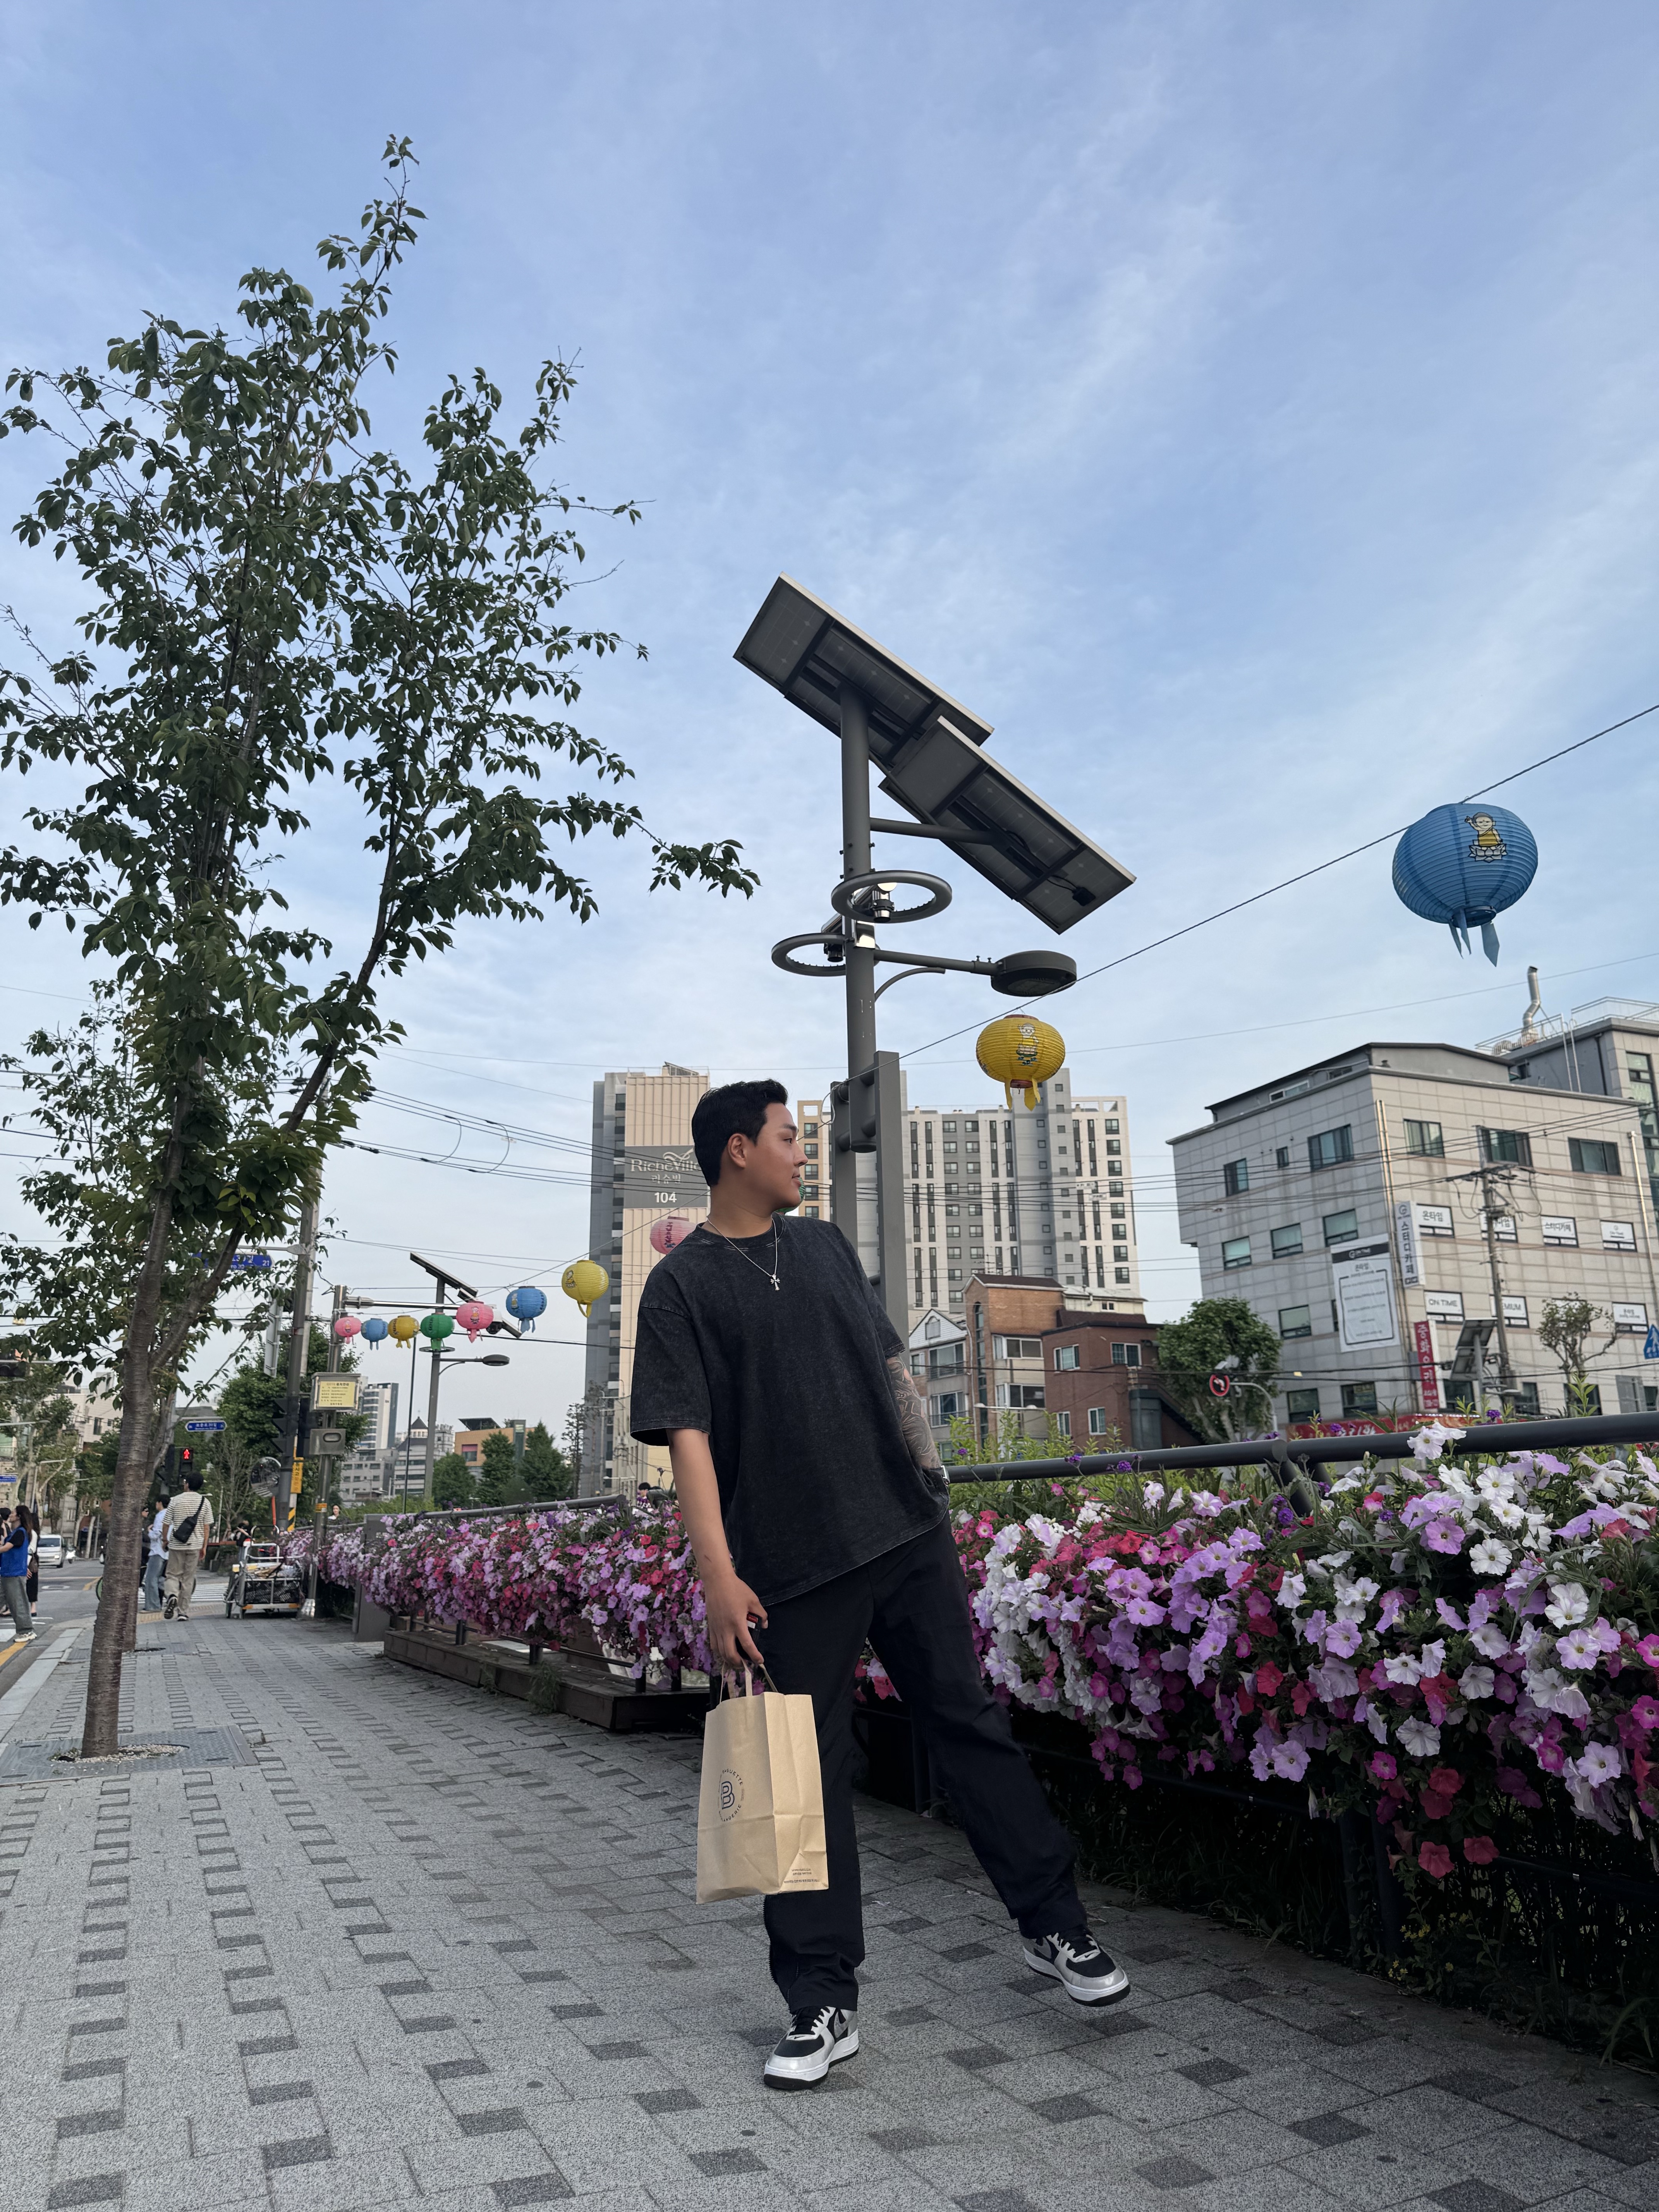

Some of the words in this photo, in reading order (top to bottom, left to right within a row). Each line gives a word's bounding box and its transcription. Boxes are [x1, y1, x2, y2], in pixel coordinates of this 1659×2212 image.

[651, 1174, 681, 1184] 리슈빌
[654, 1192, 677, 1203] 104
[1401, 1221, 1414, 1274] 스터디카페
[721, 1781, 735, 1810] B
